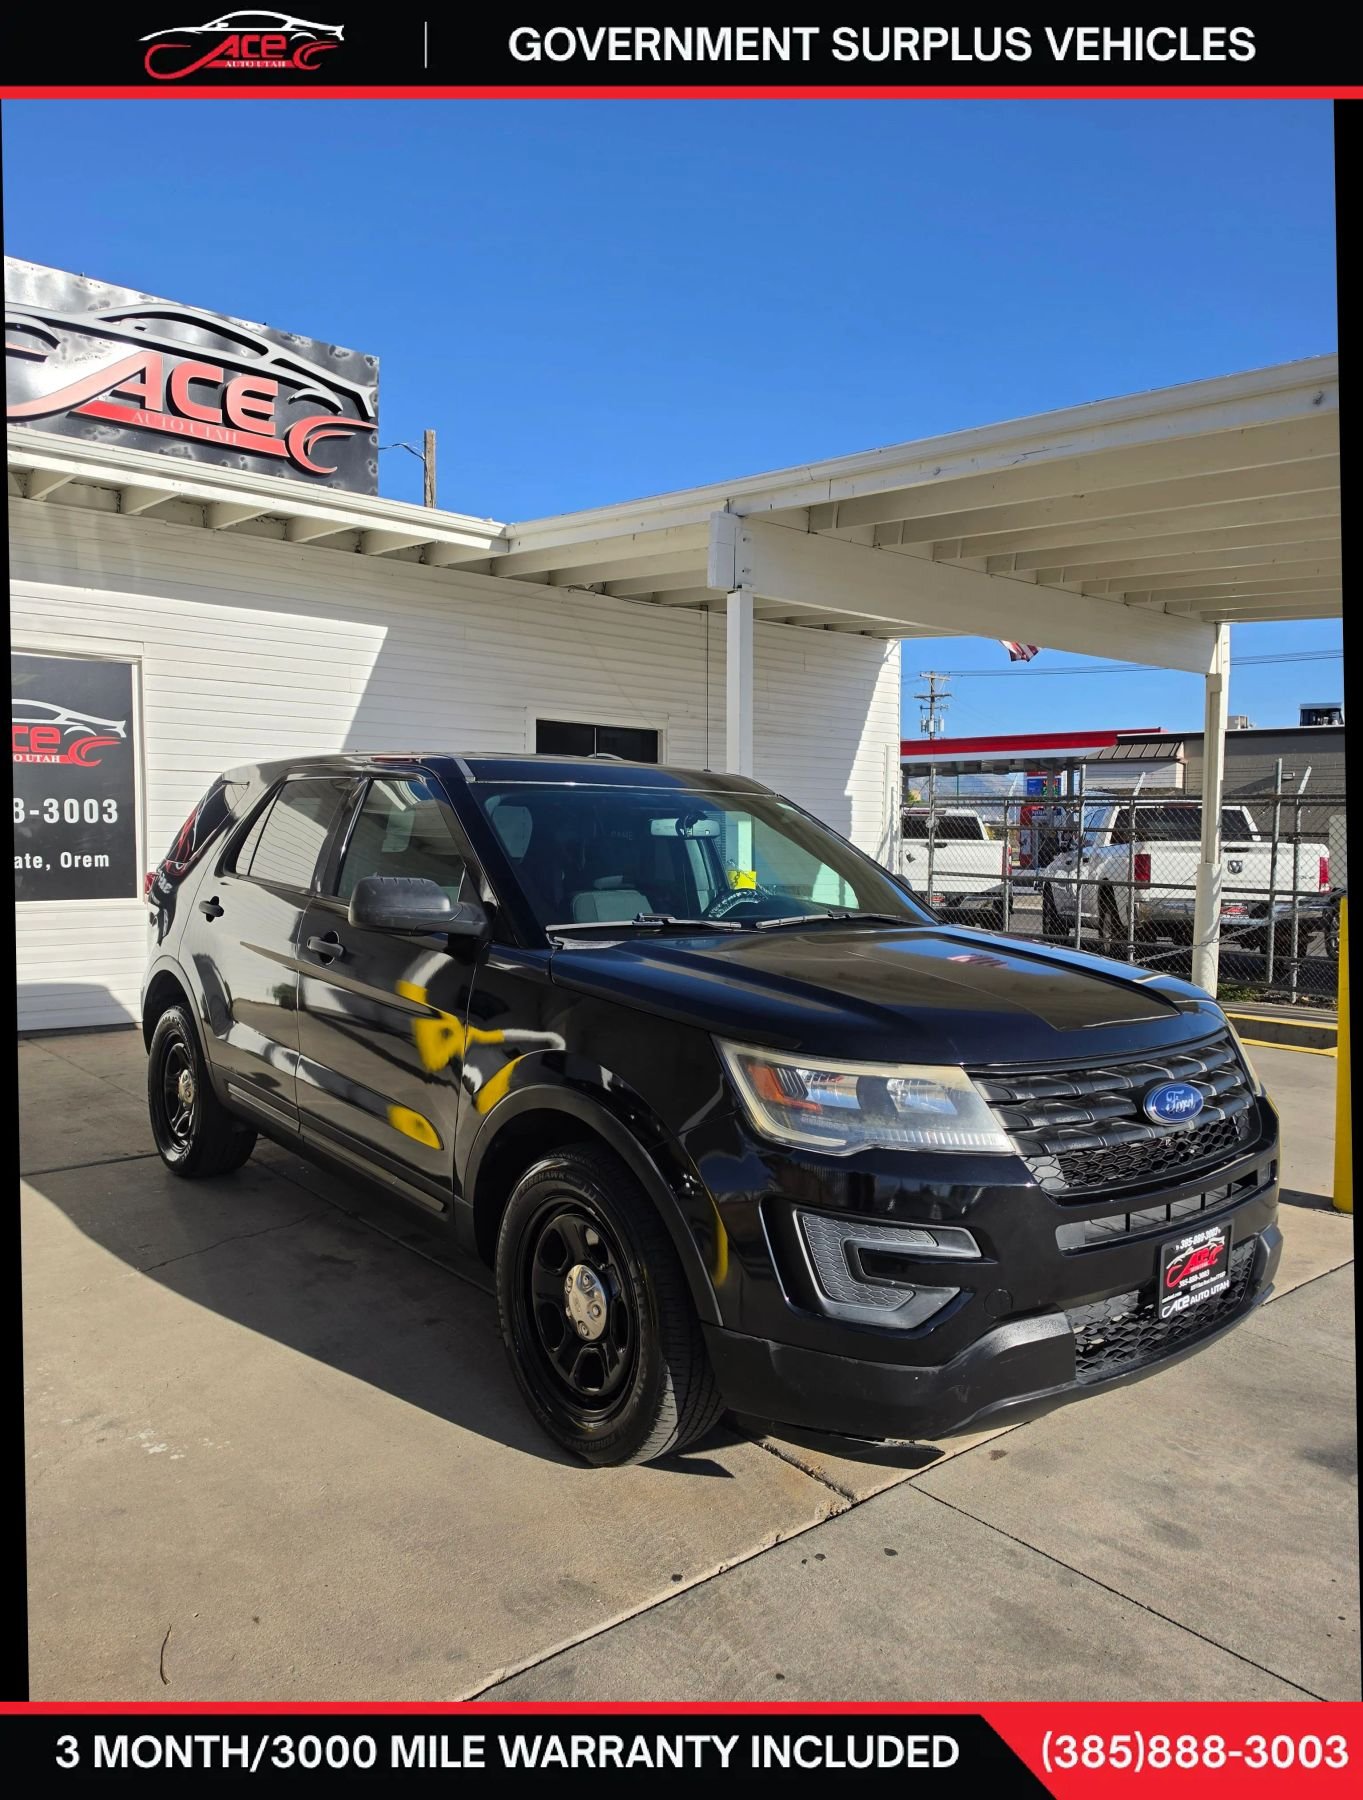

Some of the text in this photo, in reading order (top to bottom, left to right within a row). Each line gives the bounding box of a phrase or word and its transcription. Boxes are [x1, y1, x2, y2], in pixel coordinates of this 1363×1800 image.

[75, 350, 279, 436] ACE
[25, 754, 61, 763] UTAH
[14, 797, 119, 824] 8-3003
[60, 851, 110, 868] Orem
[1164, 1089, 1195, 1114] Ford
[1190, 1289, 1210, 1305] AUTO
[1211, 1279, 1230, 1295] UTAH
